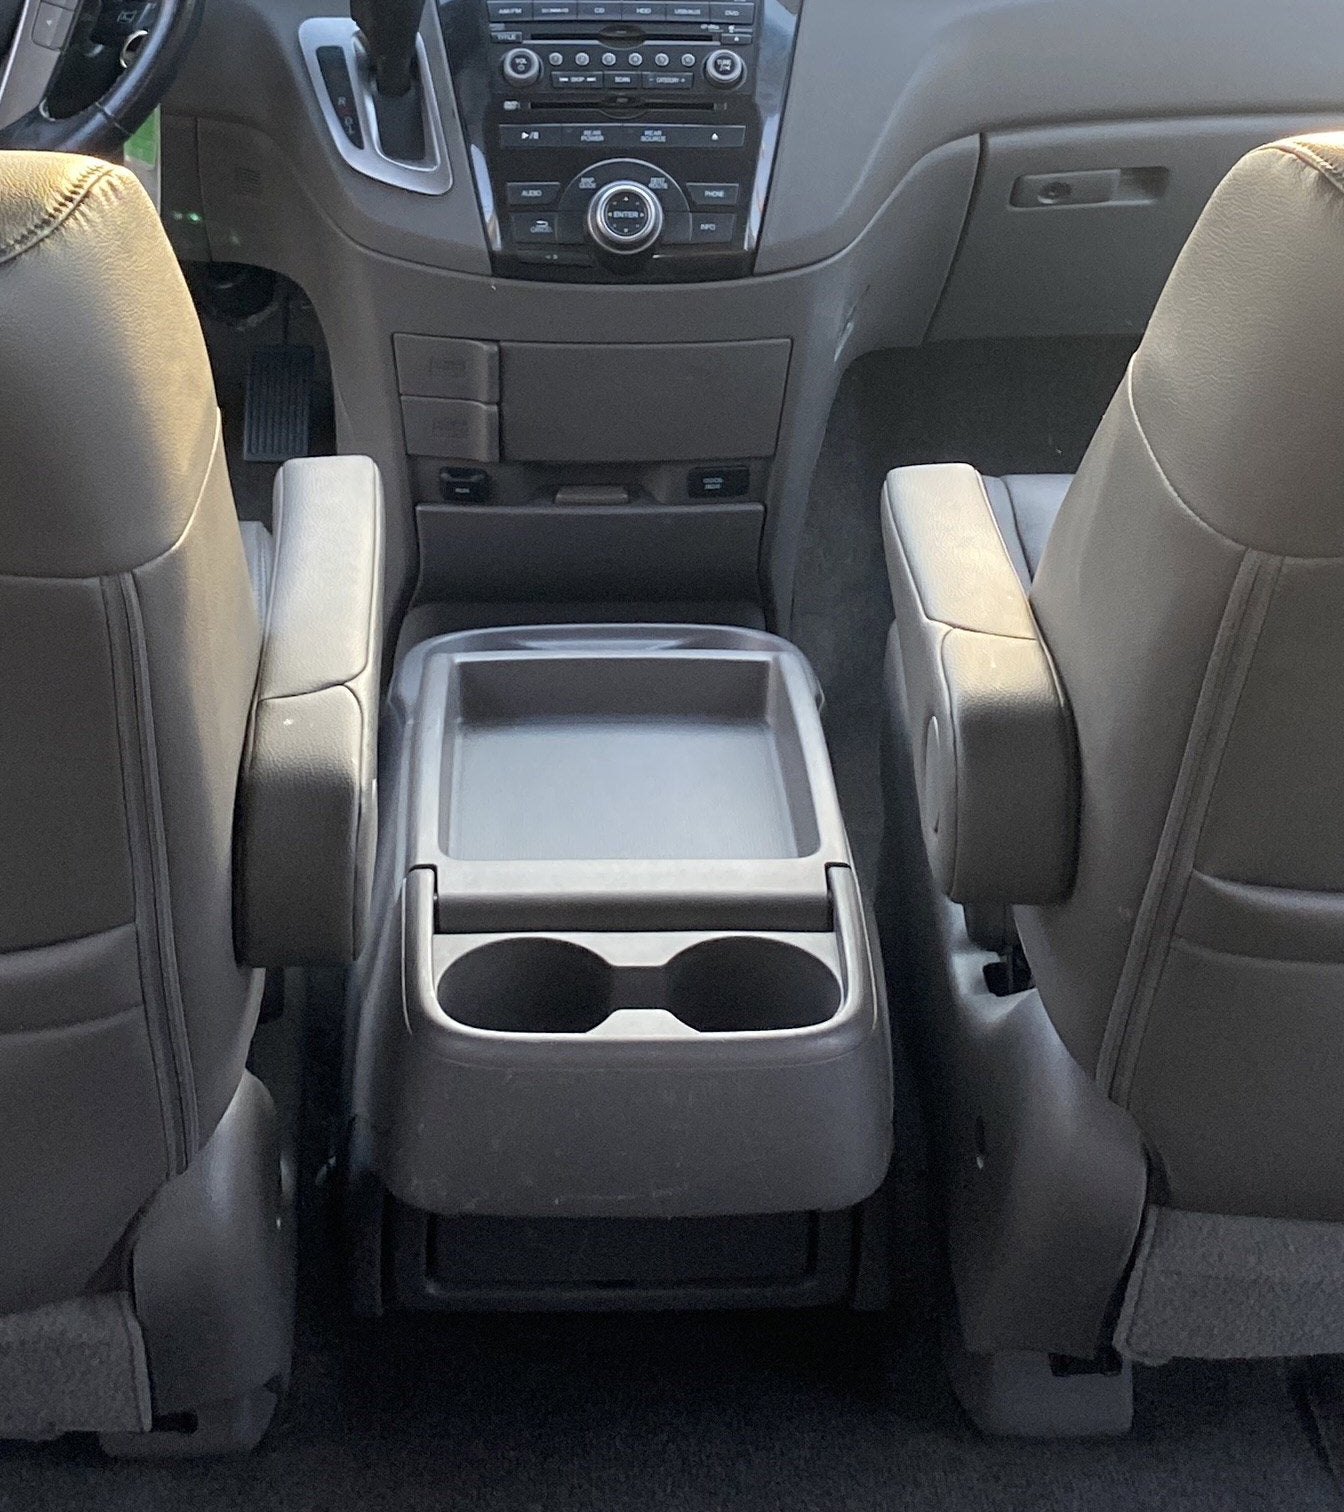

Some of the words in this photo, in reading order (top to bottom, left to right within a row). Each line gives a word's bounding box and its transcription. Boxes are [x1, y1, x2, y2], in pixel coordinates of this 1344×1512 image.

[724, 9, 740, 17] DVD
[580, 134, 605, 142] POWER
[640, 135, 667, 143] SOURCE
[521, 189, 542, 197] AUDIO
[704, 190, 725, 198] PHONE
[613, 210, 639, 219] ENTER
[530, 225, 553, 233] CANCEL
[700, 223, 716, 231] INFO
